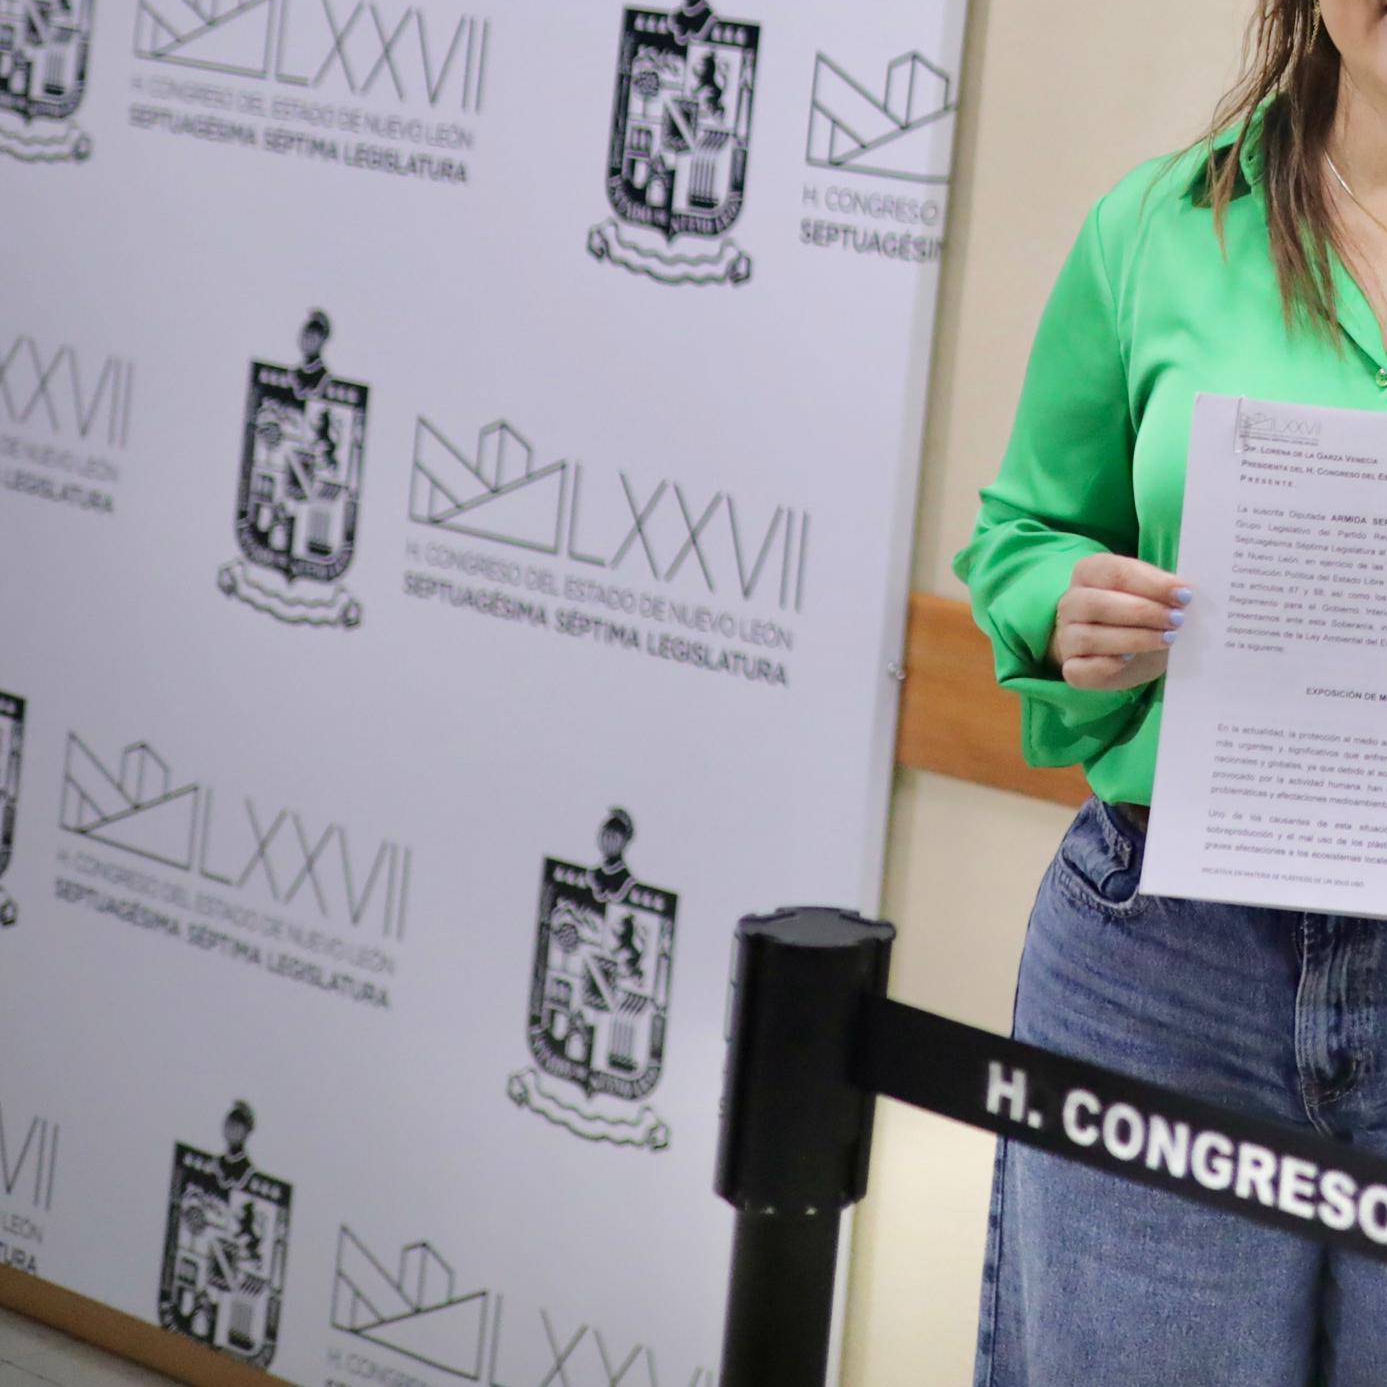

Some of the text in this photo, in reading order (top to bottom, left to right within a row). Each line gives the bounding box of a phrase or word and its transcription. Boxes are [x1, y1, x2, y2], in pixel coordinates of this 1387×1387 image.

[567, 459, 810, 614] LXXVII
[198, 782, 413, 943] LXXVII
[985, 1061, 1043, 1130] H.
